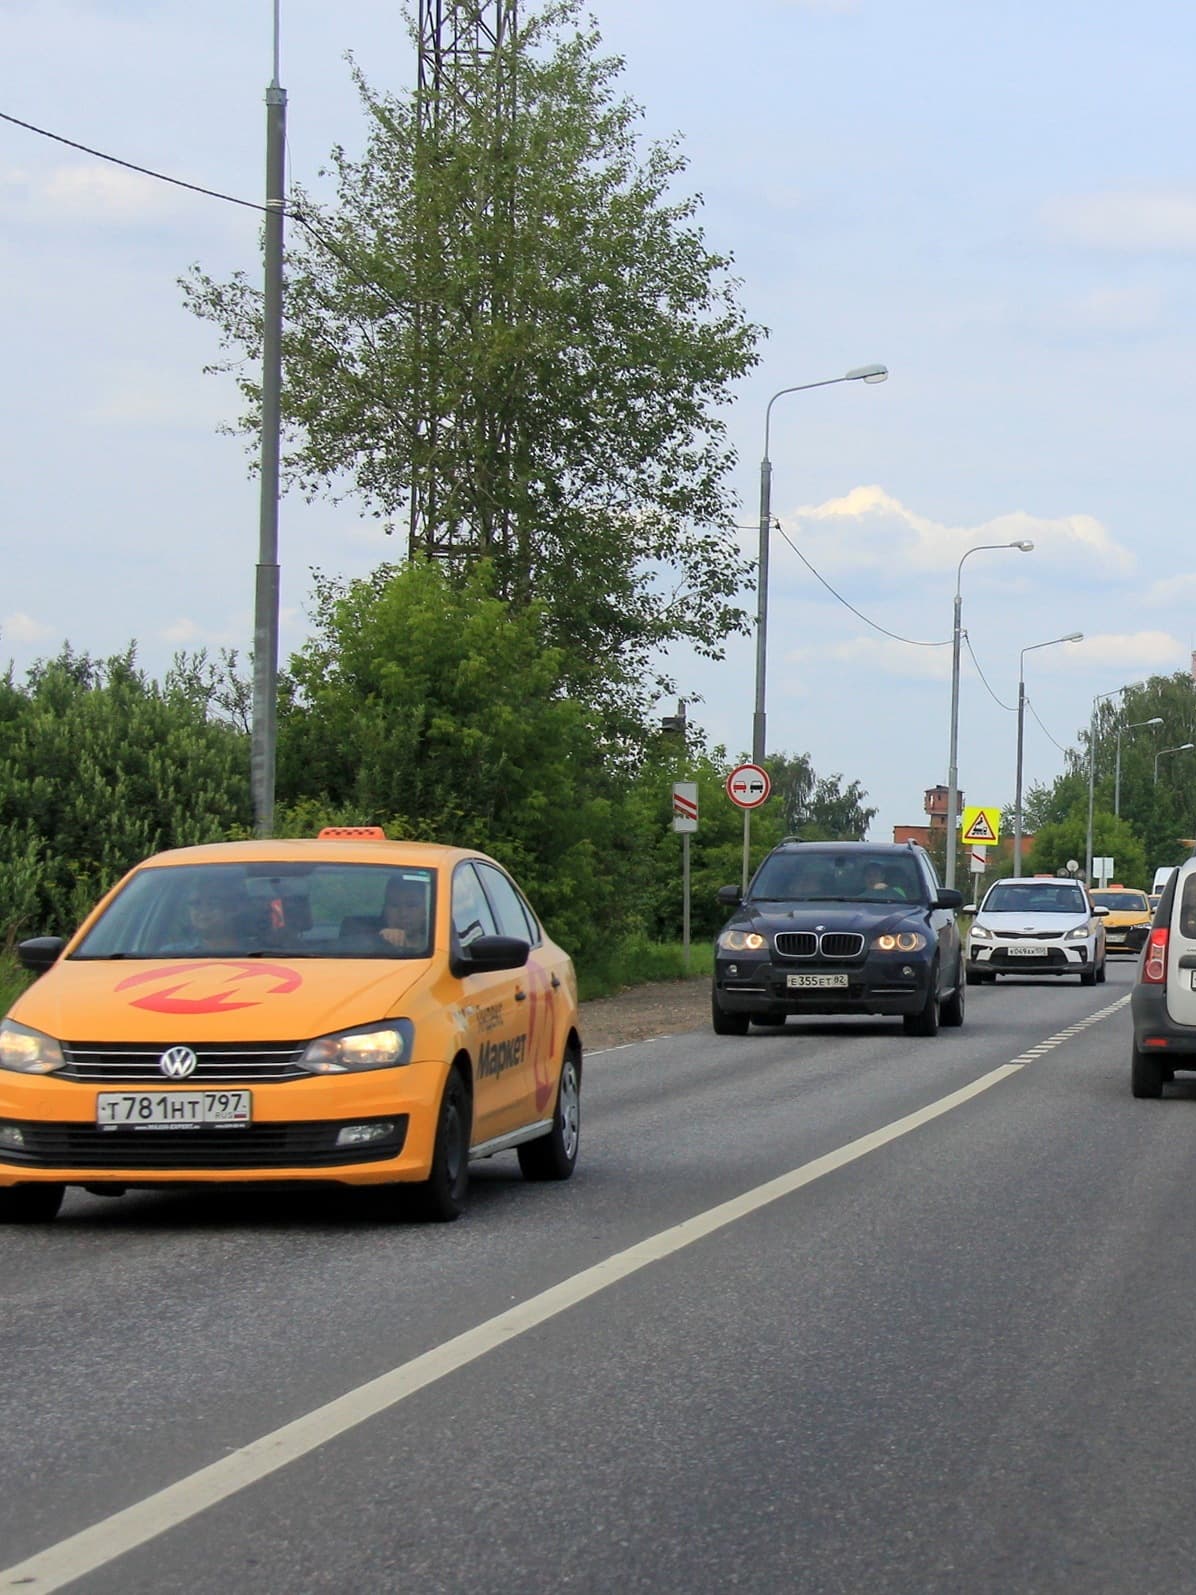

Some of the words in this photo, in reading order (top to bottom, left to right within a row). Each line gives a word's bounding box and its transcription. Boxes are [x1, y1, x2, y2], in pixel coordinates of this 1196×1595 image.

[479, 1033, 527, 1080] Маркет
[107, 1096, 200, 1120] Т781НТ
[205, 1093, 242, 1112] 797
